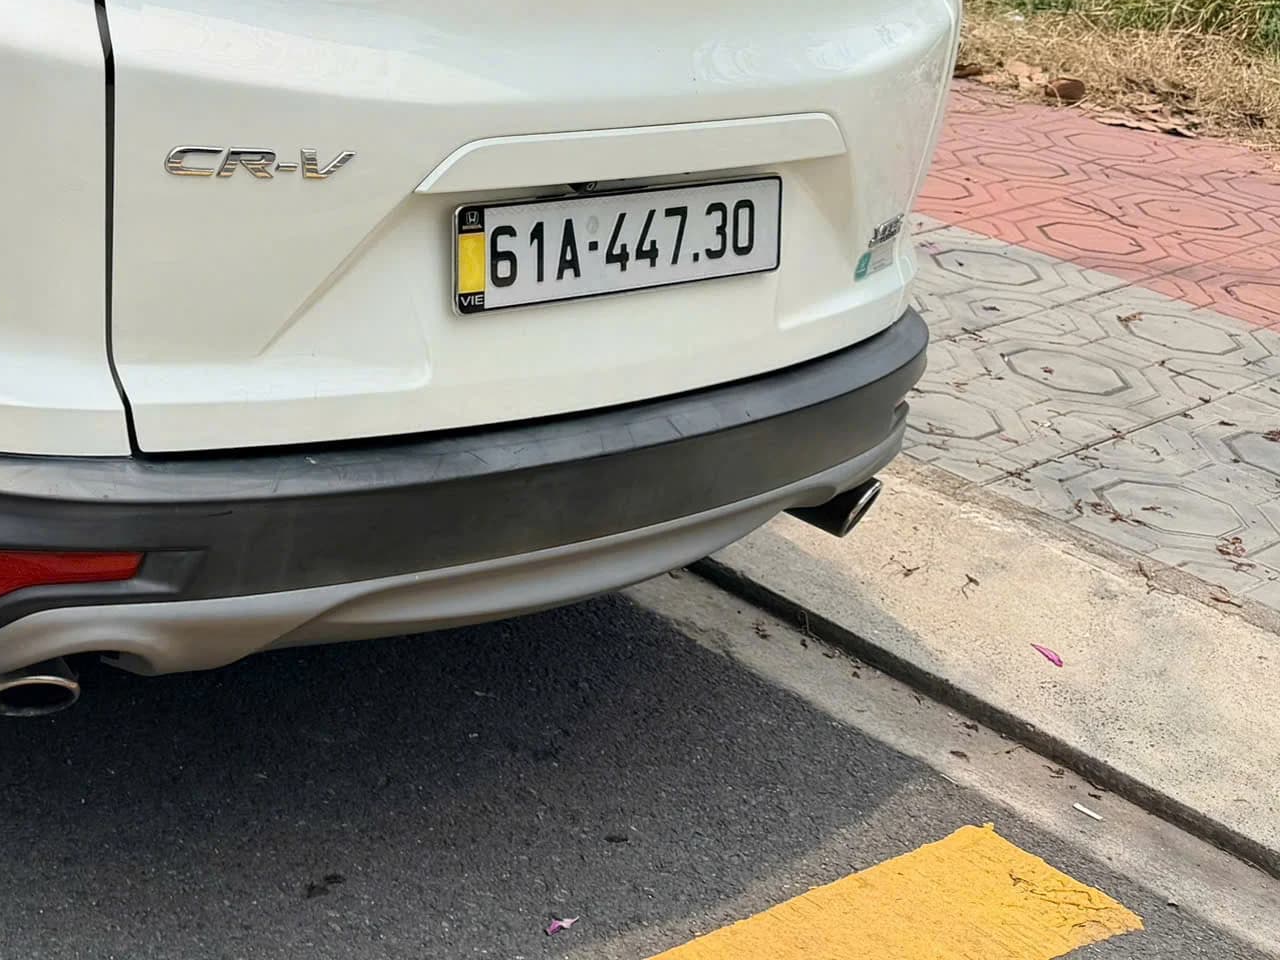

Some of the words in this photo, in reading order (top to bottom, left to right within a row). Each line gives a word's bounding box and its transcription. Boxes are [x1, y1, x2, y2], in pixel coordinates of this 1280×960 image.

[164, 146, 357, 179] CR-V
[490, 199, 755, 288] 61A-447.30
[460, 294, 484, 307] VIE
